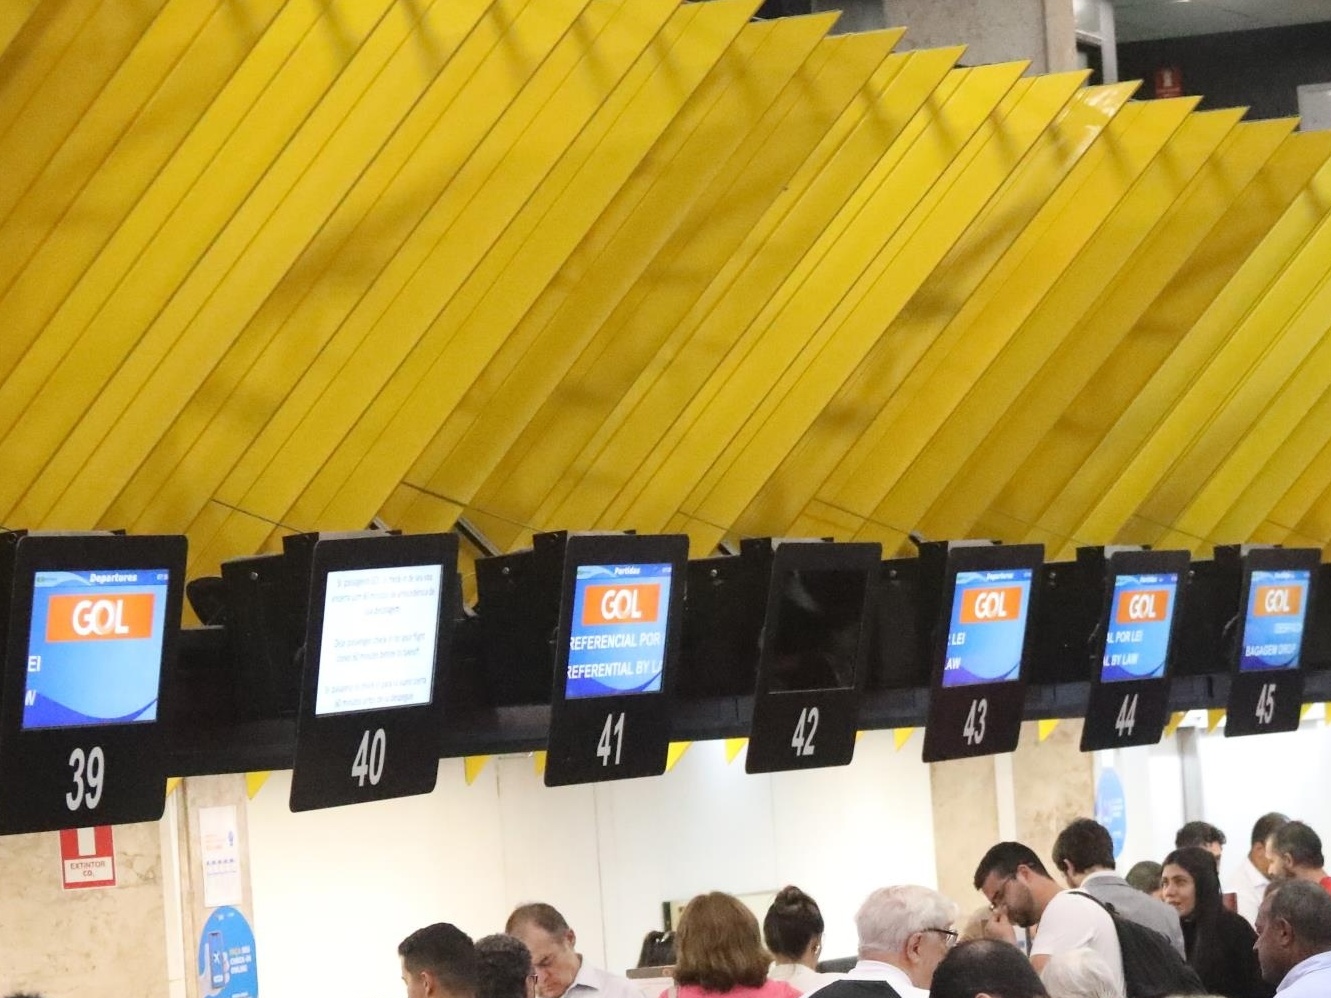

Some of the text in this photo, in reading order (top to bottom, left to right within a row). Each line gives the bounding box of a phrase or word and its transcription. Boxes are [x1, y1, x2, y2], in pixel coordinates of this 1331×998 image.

[89, 573, 138, 585] Departures
[600, 589, 642, 620] GOL
[974, 590, 1007, 619] GOL
[1129, 594, 1156, 619] GOL
[1264, 589, 1290, 613] GOL
[72, 599, 129, 636] GOL
[639, 631, 661, 647] POR
[951, 631, 966, 646] LEI
[1115, 630, 1131, 643] POR
[1131, 629, 1144, 642] LEI
[636, 660, 650, 675] BY
[1115, 694, 1138, 738] 44
[1255, 683, 1276, 725] 45
[792, 707, 820, 757] 42
[963, 698, 988, 746] 43
[596, 712, 625, 766] 41
[351, 728, 387, 788] 40
[65, 746, 105, 812] 39
[70, 860, 106, 870] EXTINTOR
